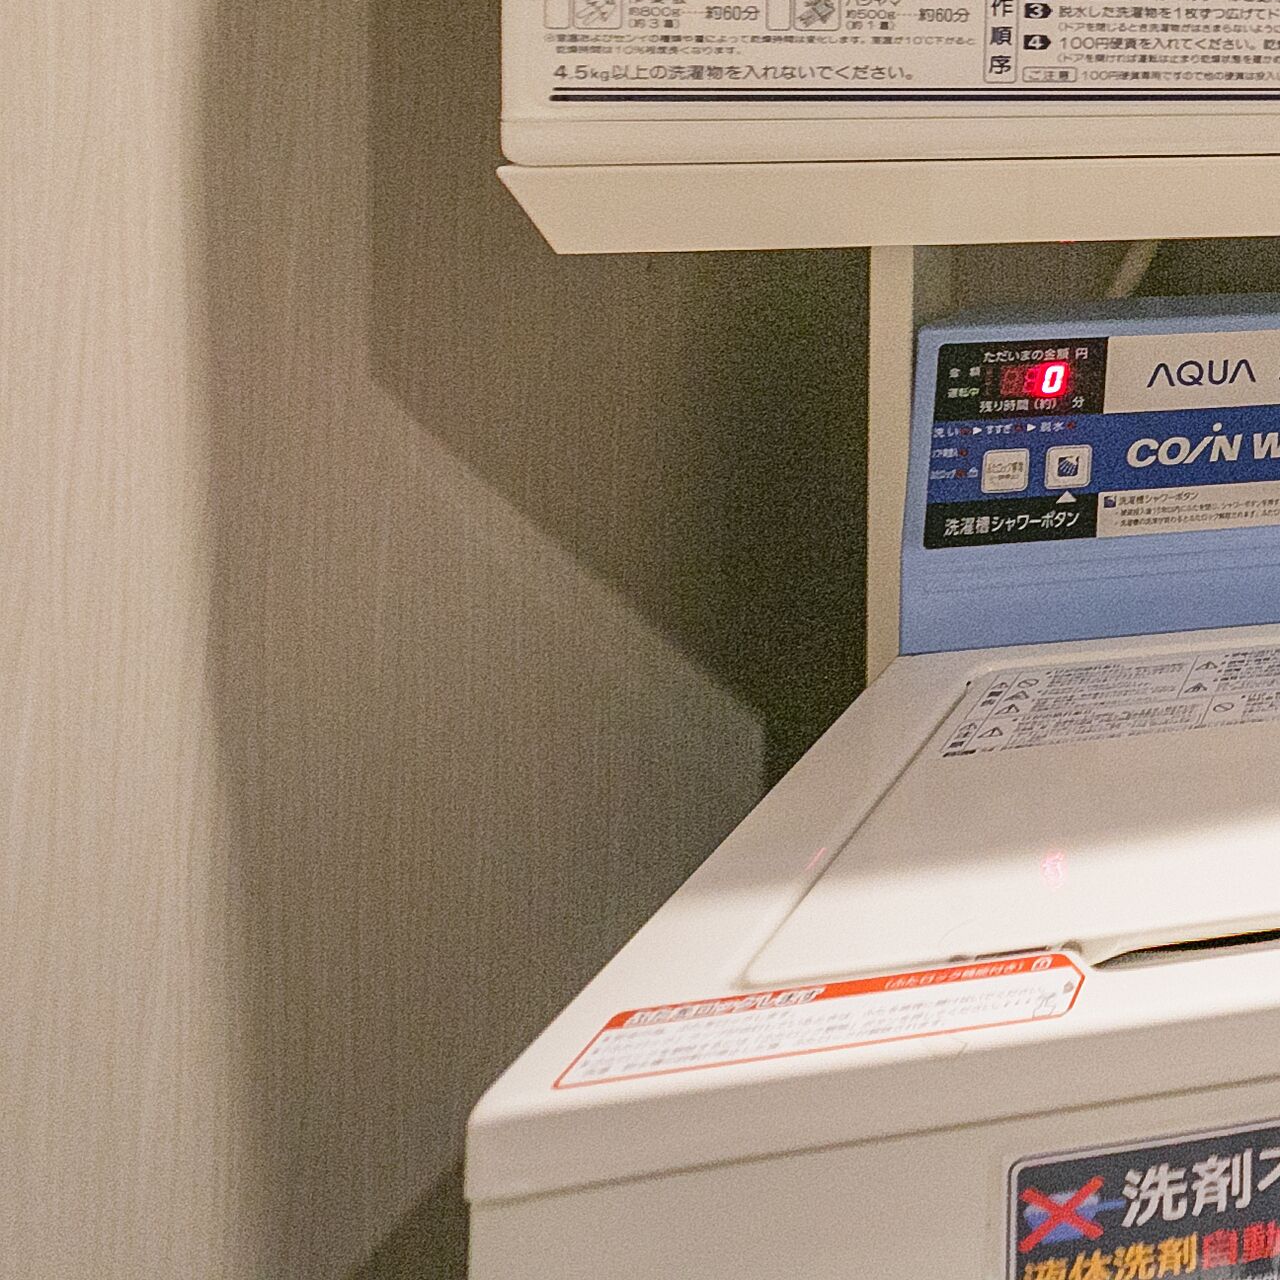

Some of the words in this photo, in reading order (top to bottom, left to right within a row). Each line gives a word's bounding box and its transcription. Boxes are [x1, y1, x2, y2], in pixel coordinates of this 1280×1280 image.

[705, 6, 760, 21] 約60分
[918, 8, 970, 23] 約60分
[553, 63, 917, 82] 4.5kg以上の洗濯物を入れないでください。
[983, 348, 1069, 363] ただいまの金額
[1075, 347, 1088, 360] 円
[1041, 365, 1065, 394] 0
[1146, 359, 1257, 389] AQUA
[1072, 397, 1085, 408] 分
